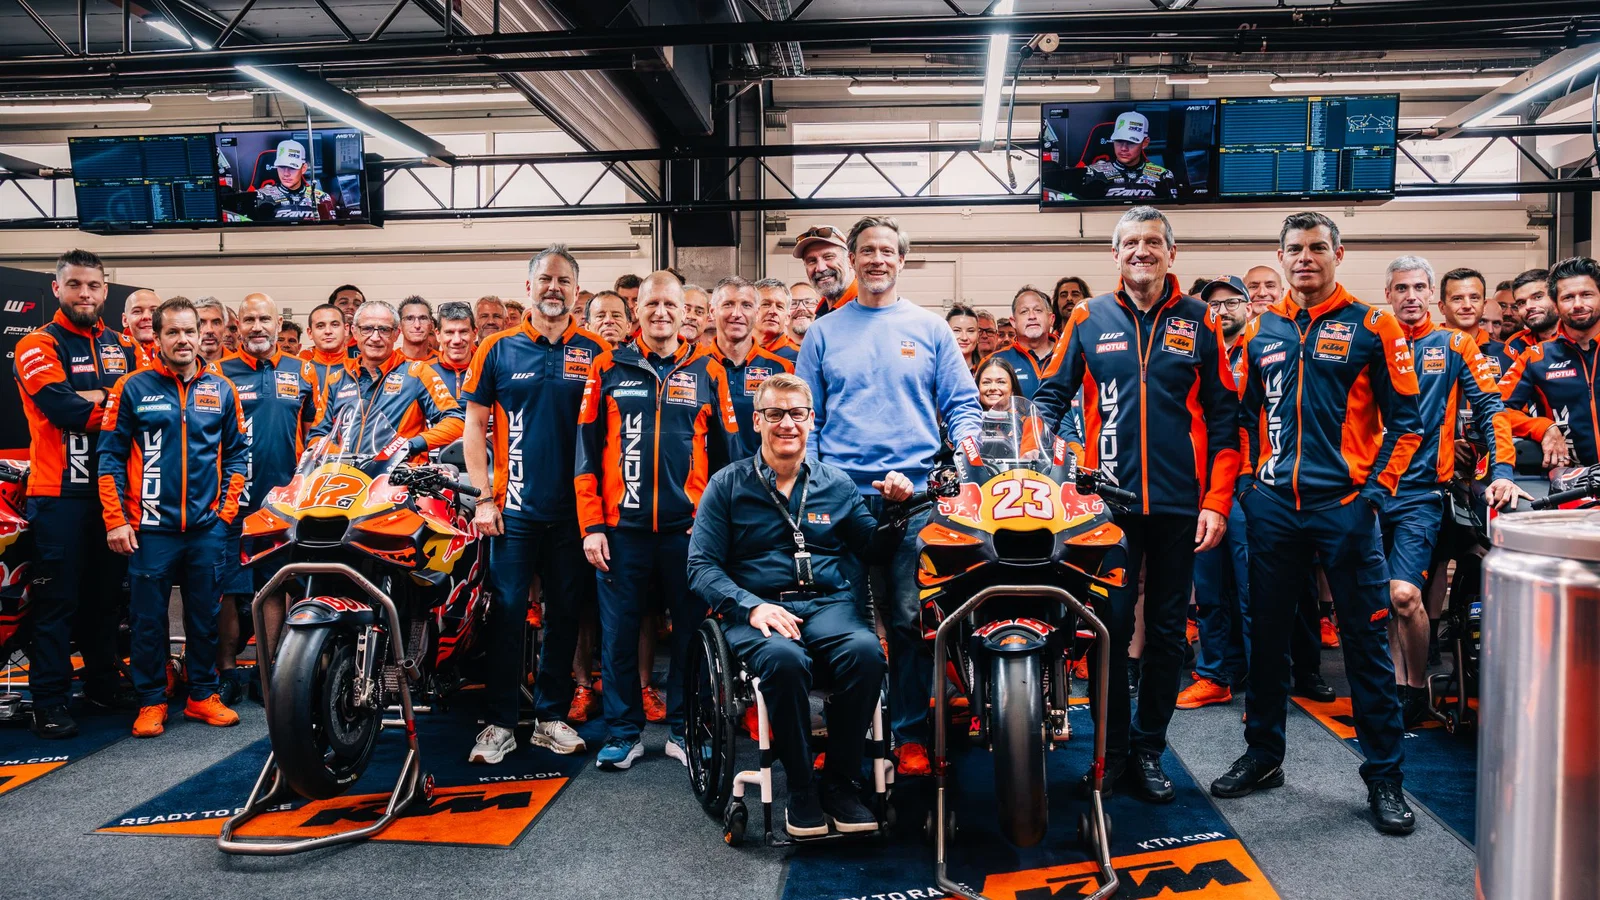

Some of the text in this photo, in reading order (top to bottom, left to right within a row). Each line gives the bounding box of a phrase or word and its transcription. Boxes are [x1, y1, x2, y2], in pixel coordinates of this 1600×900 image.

[3, 300, 36, 313] WP
[1099, 332, 1125, 340] WP
[1169, 337, 1190, 347] KTM
[1319, 330, 1352, 341] Red Bull
[1097, 342, 1127, 353] MOTUL
[1262, 341, 1283, 353] WP
[1321, 342, 1345, 352] KTM
[1261, 352, 1286, 366] MOTUL
[1548, 359, 1572, 369] WP
[568, 365, 587, 373] KTM
[1547, 369, 1576, 379] MOTUL
[511, 372, 536, 380] WP
[141, 394, 165, 402] WP
[1100, 378, 1121, 487] ACING
[383, 436, 408, 458] MOTUL
[963, 437, 978, 462] MOTUL
[1055, 438, 1066, 462] MOTUL
[69, 431, 90, 484] RAC
[505, 407, 524, 511] RACING
[623, 412, 642, 509] RACING
[140, 428, 163, 526] RACING
[296, 473, 367, 511] 12
[992, 479, 1053, 521] 23
[478, 771, 562, 782] KTM.COM
[119, 811, 197, 825] READY
[201, 810, 229, 818] TO
[1137, 831, 1226, 850] KTM.COM
